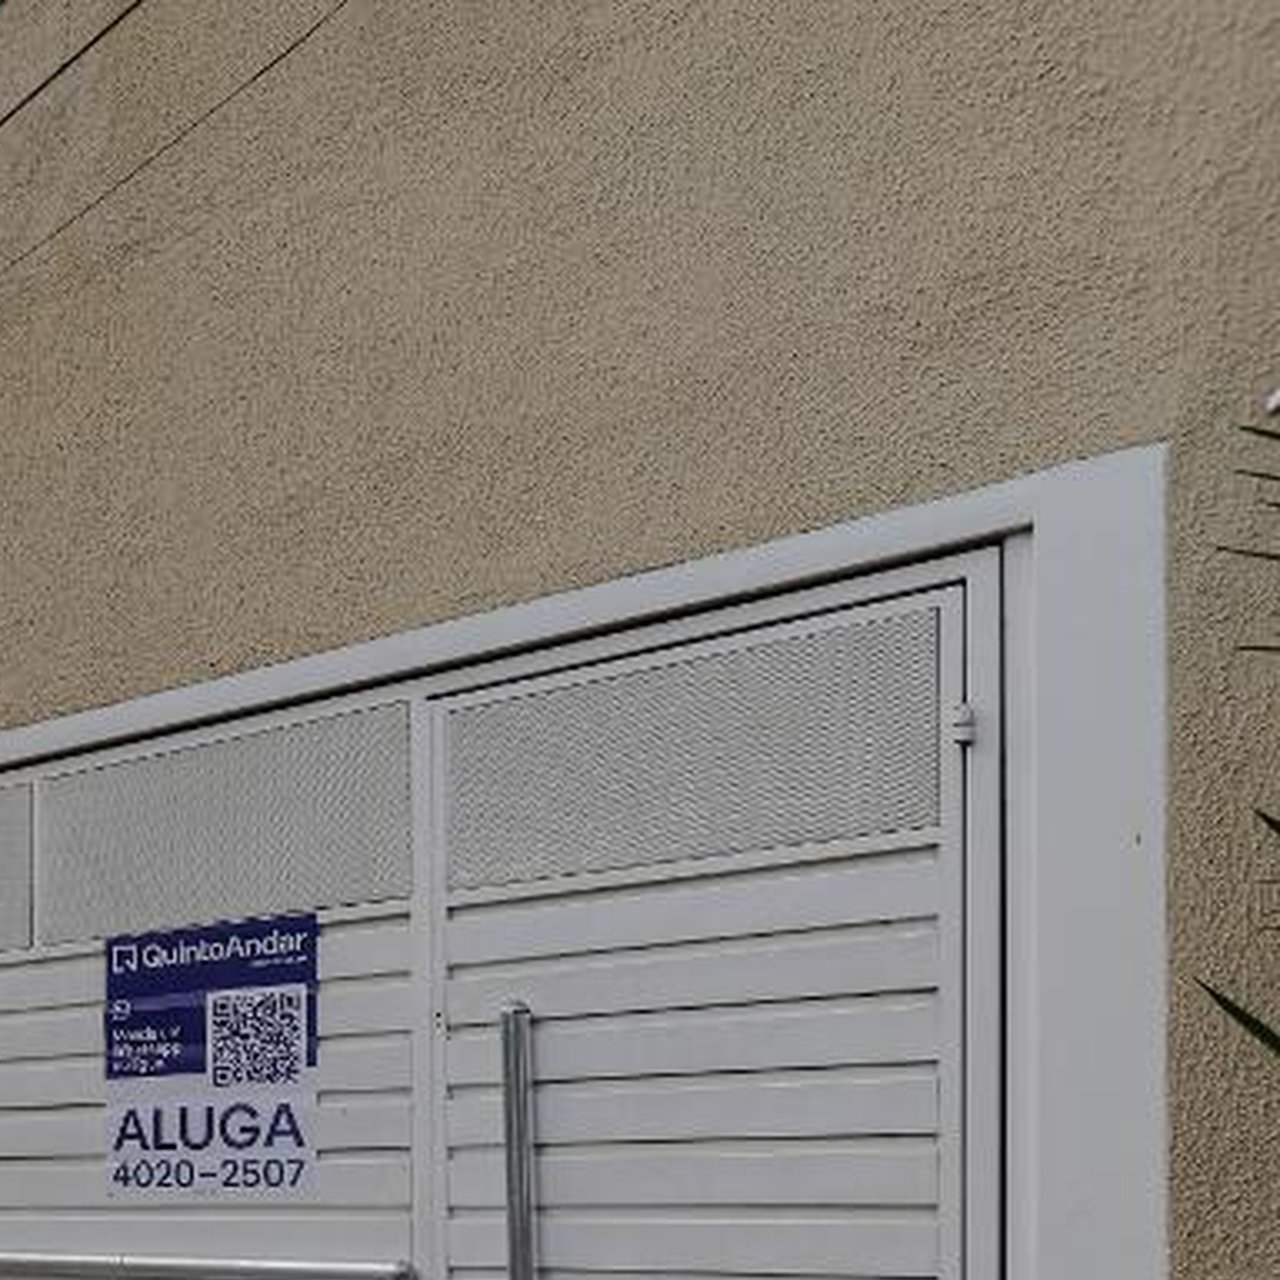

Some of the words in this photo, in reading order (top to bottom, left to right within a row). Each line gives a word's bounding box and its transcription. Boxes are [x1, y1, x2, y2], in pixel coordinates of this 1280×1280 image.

[142, 929, 308, 967] QuintoAndar
[113, 1103, 306, 1151] ALUGA
[113, 1158, 306, 1188] 4020-2507
